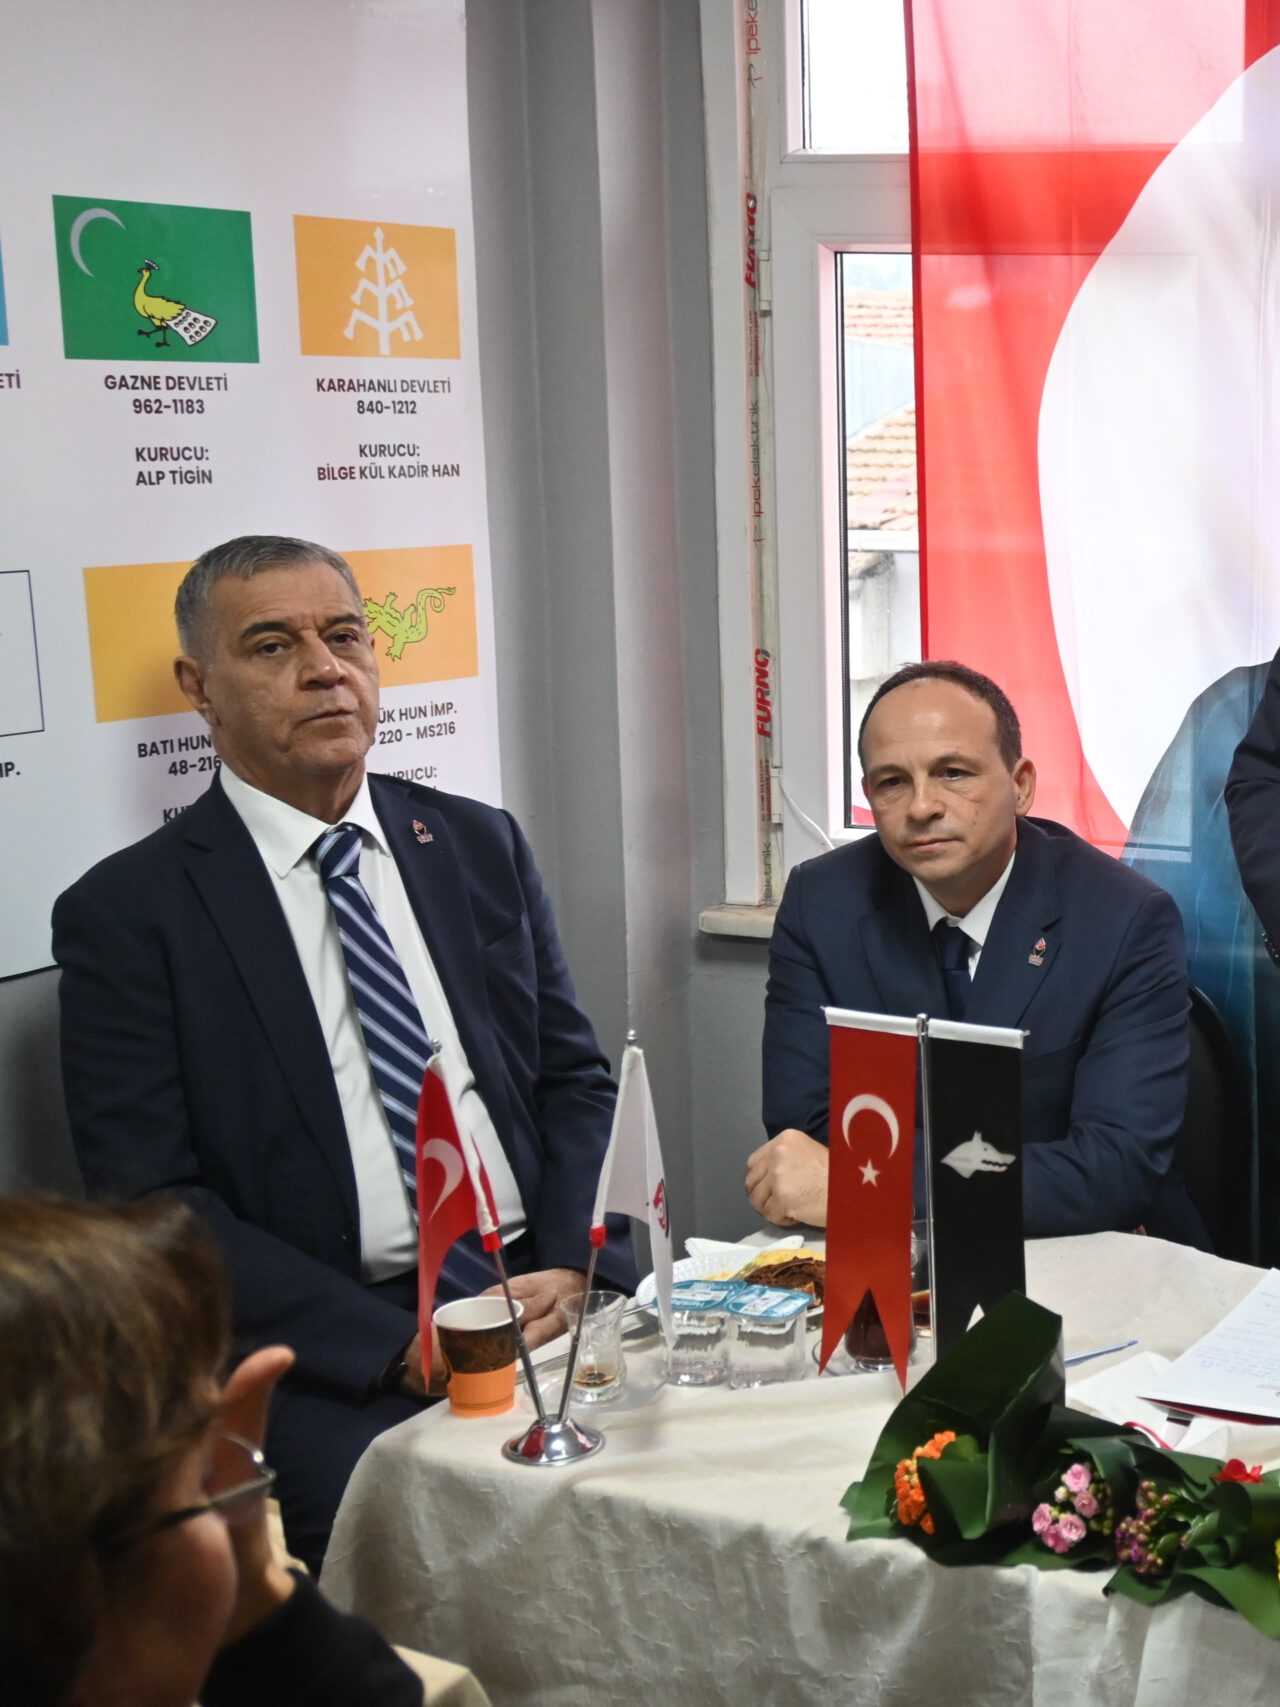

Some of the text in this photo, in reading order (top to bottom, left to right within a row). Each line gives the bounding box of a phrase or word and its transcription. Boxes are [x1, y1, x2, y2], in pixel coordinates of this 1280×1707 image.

[104, 372, 228, 392] GAZNE DEVLETİ
[316, 377, 451, 394] KARAHANLI DEVLETİ
[133, 398, 205, 415] 962-1183
[357, 400, 417, 415] 840-1212
[135, 447, 209, 462] KURUCU:
[359, 444, 420, 458] KURUCU:
[136, 466, 213, 487] ALP TİGİN
[317, 461, 460, 481] BİLGE KÜL KADİR HAN
[399, 705, 427, 721] HUN
[431, 700, 458, 718] İMP.
[379, 728, 402, 745] 220
[416, 721, 456, 741] MS216
[138, 734, 212, 758] BATI HUN
[168, 755, 222, 776] 48-216
